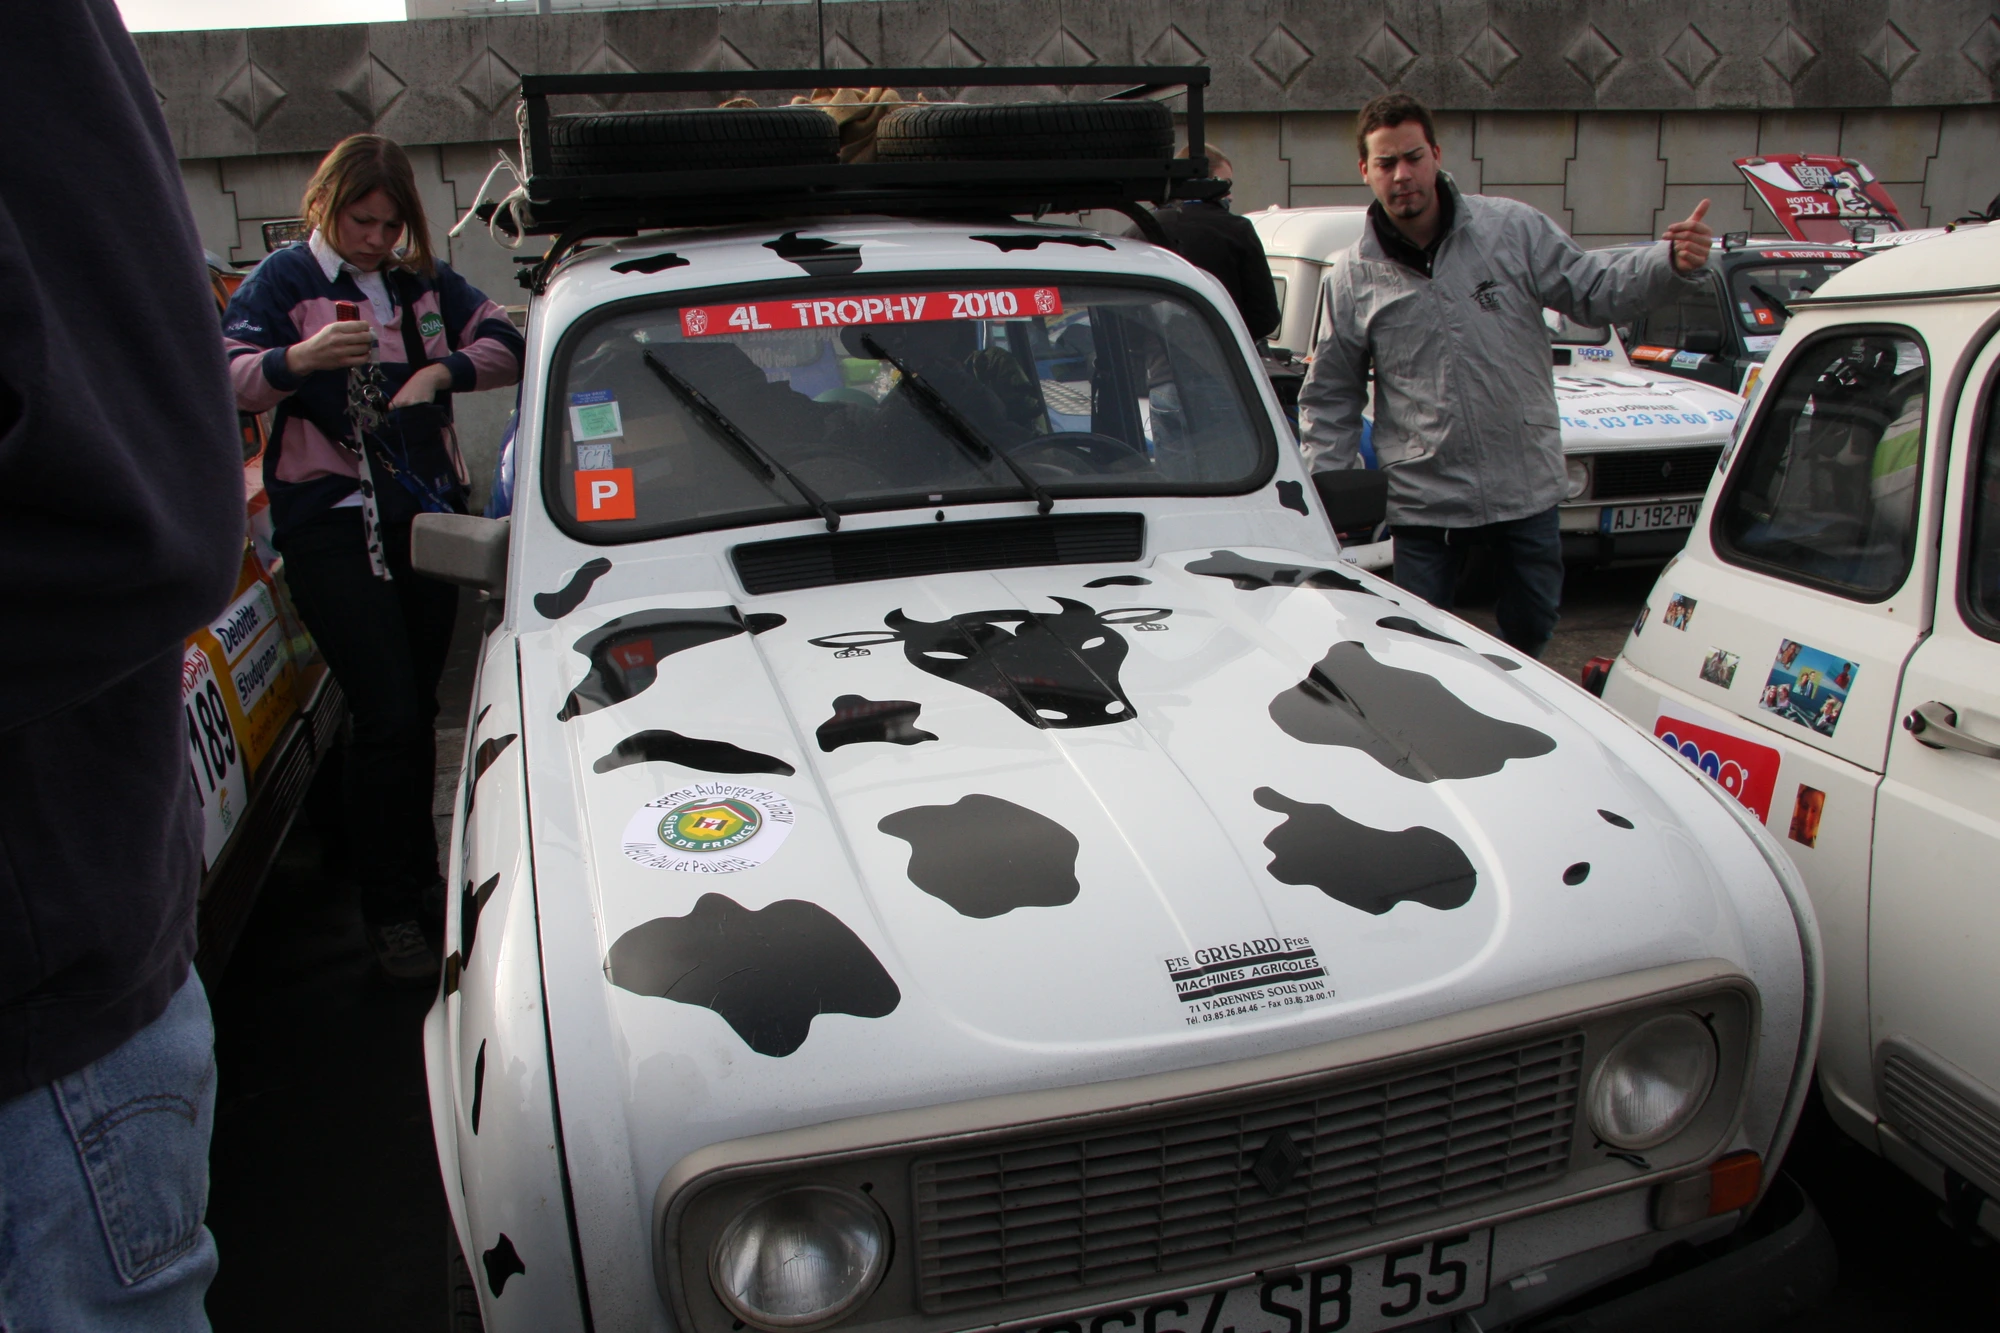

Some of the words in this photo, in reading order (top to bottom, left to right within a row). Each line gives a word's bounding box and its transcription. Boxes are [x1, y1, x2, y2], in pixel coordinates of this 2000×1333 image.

[1789, 203, 1830, 216] KFC
[1790, 251, 1825, 259] TROPHY
[729, 305, 771, 332] 4L
[792, 295, 927, 327] TROPHY
[948, 290, 1019, 320] 2010
[1759, 311, 1768, 321] P
[421, 319, 444, 332] OVAL
[1600, 416, 1626, 429] 03
[1627, 413, 1654, 427] 29
[1654, 413, 1681, 425] 36
[1681, 413, 1707, 425] 60
[1707, 409, 1735, 422] 30
[591, 480, 619, 509] P
[237, 644, 278, 703] Studyrama
[644, 789, 696, 810] Ferme
[695, 781, 754, 799] Auberge
[752, 790, 774, 803] de
[675, 839, 696, 849] DE
[702, 824, 756, 849] FRANCE
[650, 852, 681, 870] Paul
[675, 859, 690, 872] et
[1194, 937, 1281, 965] GRISARD
[1175, 969, 1245, 992] MACHINES
[1252, 957, 1319, 978] AGRICOLES
[1189, 1004, 1201, 1013] 71
[1203, 990, 1265, 1011] VARENNES
[1267, 984, 1297, 998] SOUS
[1299, 980, 1325, 993] DUN
[1186, 1017, 1201, 1026] Tél.
[1268, 1000, 1282, 1009] Fax
[1260, 1263, 1352, 1333] SB
[1380, 1233, 1470, 1317] 55
